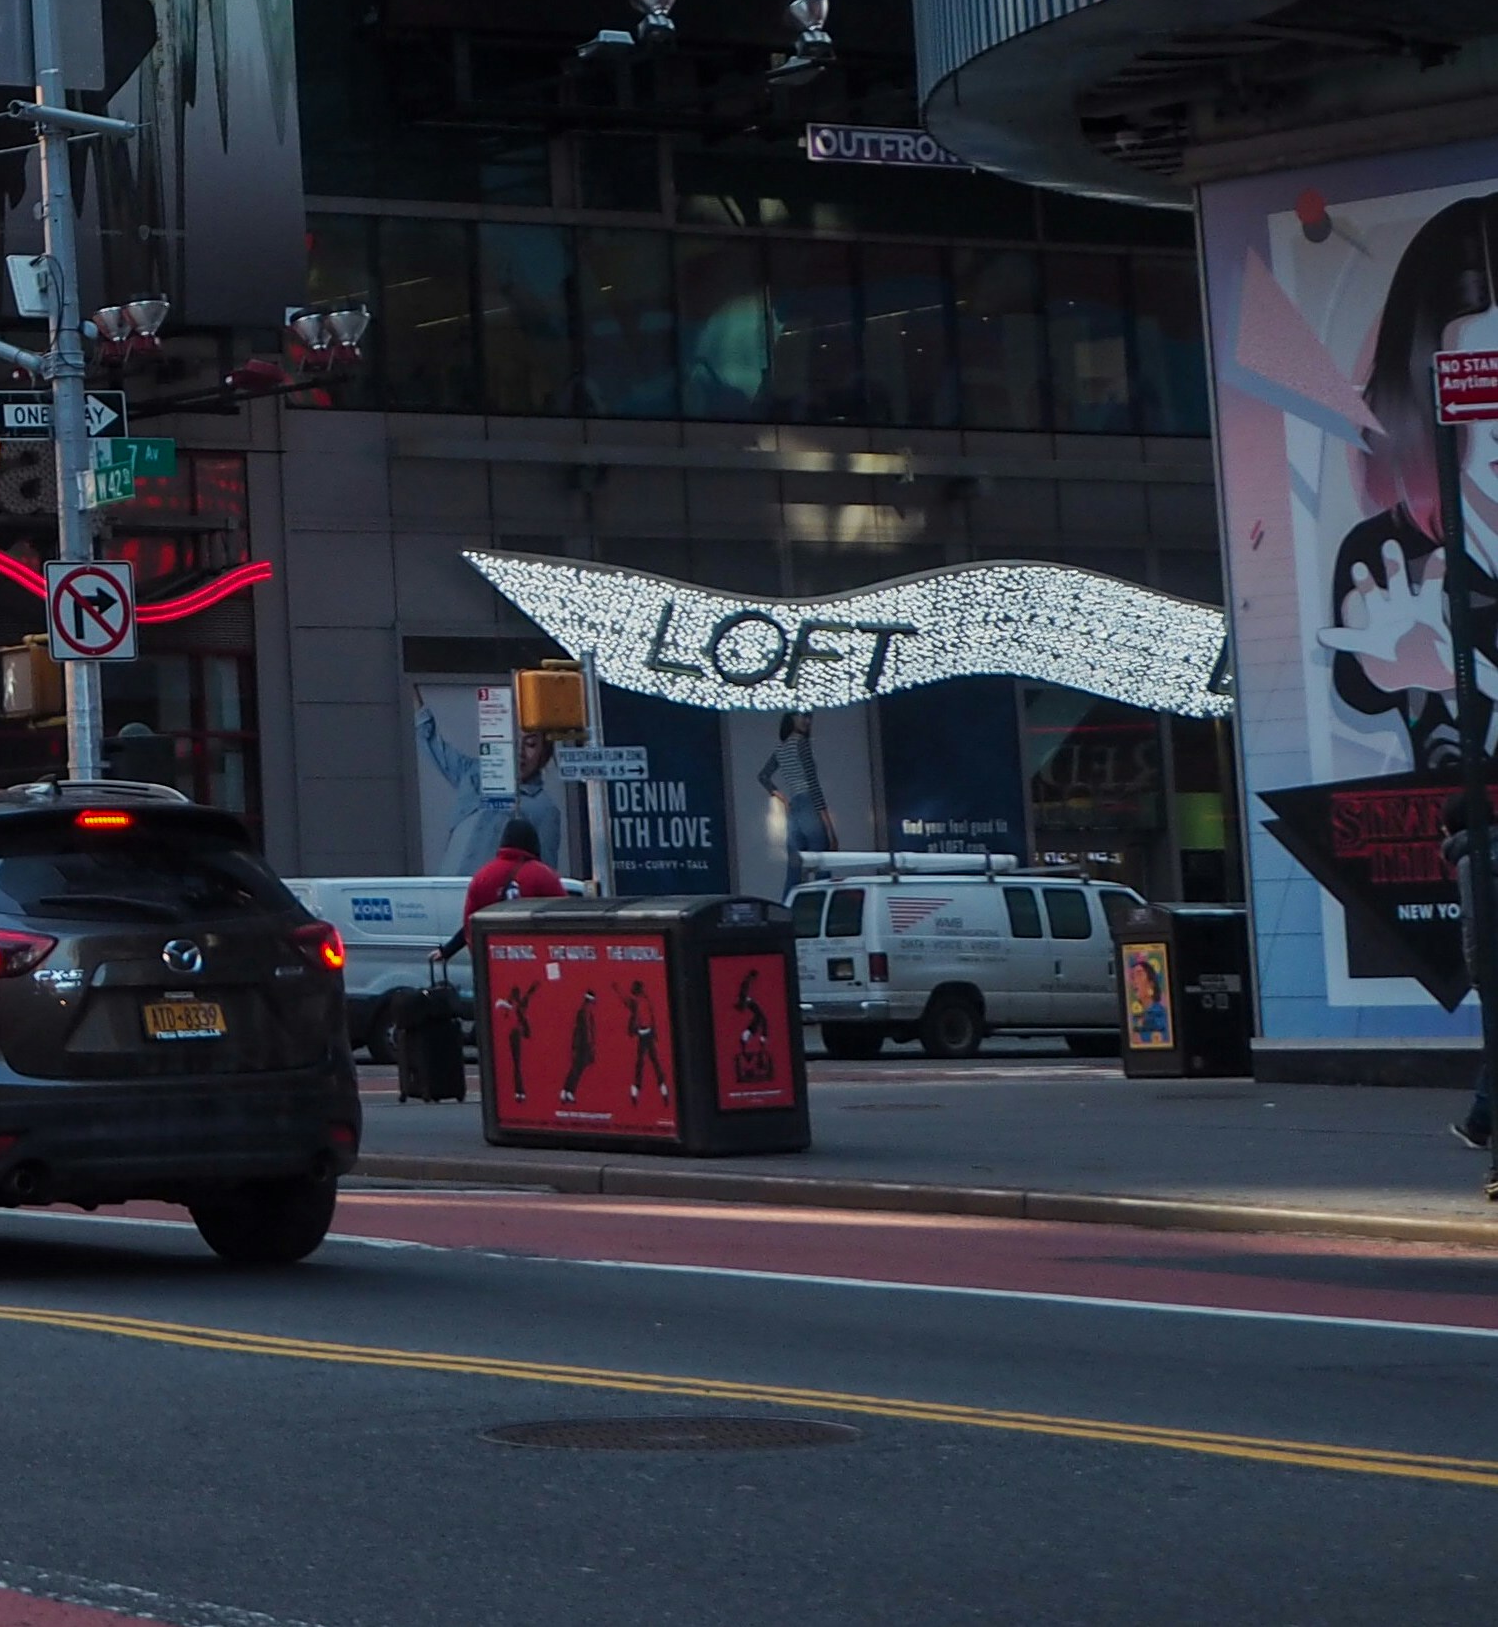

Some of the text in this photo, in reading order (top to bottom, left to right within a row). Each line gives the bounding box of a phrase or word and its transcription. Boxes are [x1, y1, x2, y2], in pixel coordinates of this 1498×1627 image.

[814, 128, 958, 164] OUTFRO
[1440, 359, 1461, 374] NO
[14, 406, 50, 425] ONE
[647, 602, 919, 689] LOFT
[614, 781, 687, 813] DENIM
[613, 816, 713, 849] ITH LOVE
[644, 859, 678, 870] CURVY
[686, 859, 709, 870] TALL
[1397, 903, 1462, 920] NEW YO
[33, 969, 85, 982] CX-5
